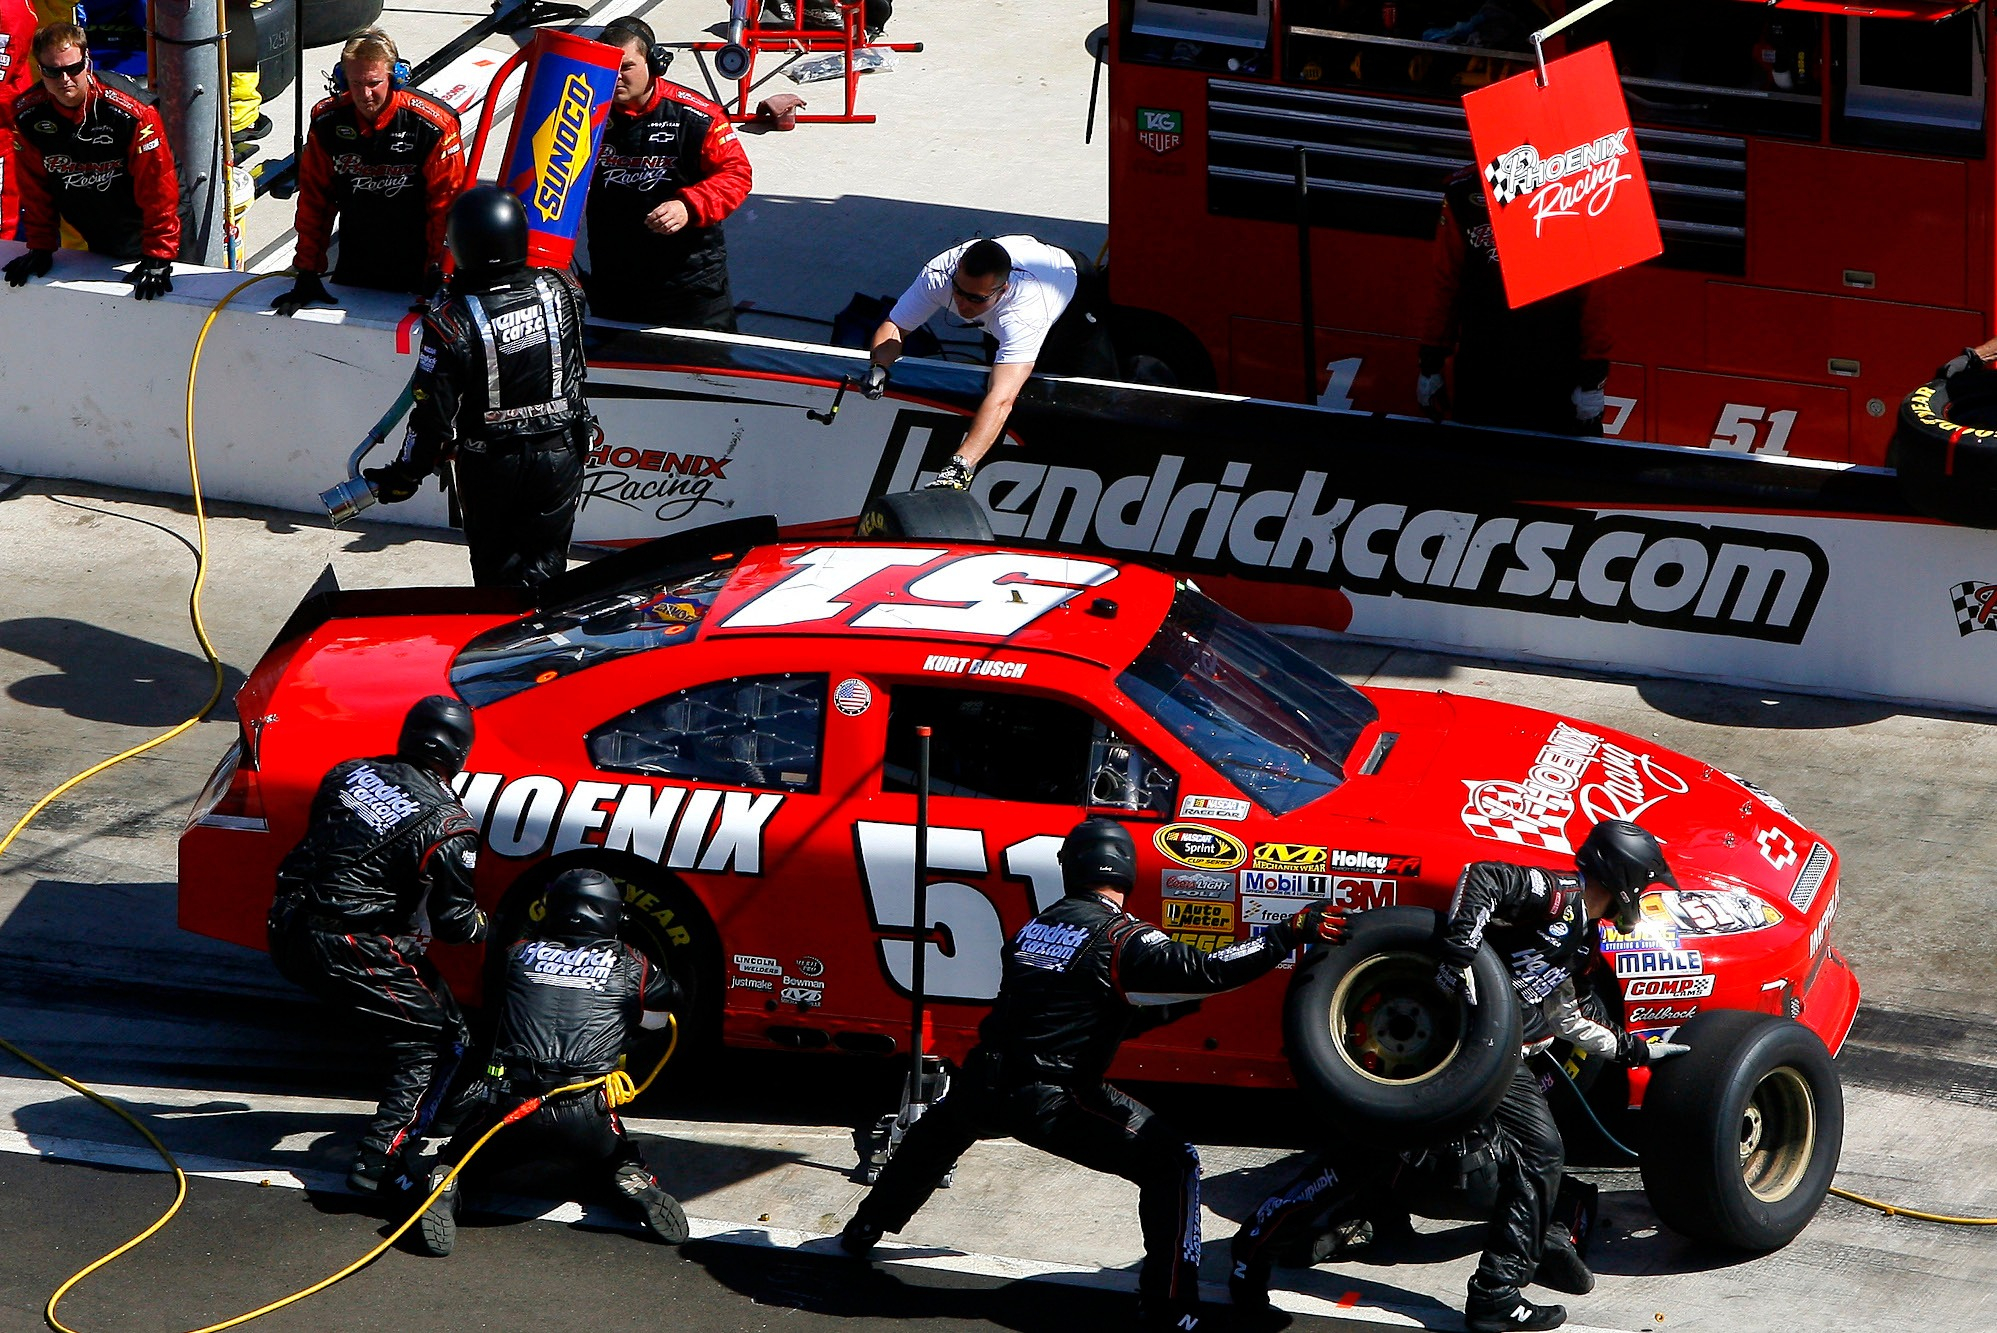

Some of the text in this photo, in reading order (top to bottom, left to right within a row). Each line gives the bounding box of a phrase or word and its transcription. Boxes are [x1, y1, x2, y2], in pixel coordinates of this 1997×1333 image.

[1144, 111, 1175, 131] TAG
[534, 78, 595, 218] SUNOCO
[1140, 132, 1180, 152] HEUER
[1500, 127, 1630, 194] PHOENIX
[62, 170, 124, 192] Racing
[351, 174, 414, 198] Racing
[602, 167, 672, 192] Racing
[1527, 157, 1633, 239] Racing
[1710, 403, 1797, 456] 51
[586, 424, 733, 481] HOENIX
[580, 470, 734, 521] Racing
[720, 546, 1120, 637] 51
[923, 654, 1028, 679] KURT BUSCH
[1473, 721, 1604, 828] PHOENIX
[346, 764, 420, 819] Hendrick
[1579, 738, 1690, 843] Racing
[349, 785, 402, 826] cars.com
[450, 771, 784, 874] HOENIX
[1184, 842, 1216, 855] Sprint
[1187, 856, 1234, 866] CUP SERIES
[1253, 860, 1326, 873] MECHANIX WEAR
[1332, 850, 1389, 875] Holley
[1196, 879, 1231, 891] LIGHT
[1246, 872, 1302, 892] Mobil
[1173, 890, 1222, 899] POLE
[1336, 879, 1395, 912] 3M
[1180, 915, 1230, 927] Meter
[1183, 904, 1222, 916] Auto
[1678, 897, 1736, 929] 51
[1015, 917, 1090, 948] Hendrick
[520, 940, 618, 969] Hendrick
[735, 956, 776, 966] LINCOLN
[1617, 951, 1701, 974] MAHLE
[535, 959, 612, 979] cars.com
[743, 965, 780, 975] WELDERS
[731, 975, 773, 990] justmake
[783, 975, 825, 989] Bowman
[1630, 979, 1694, 996] COMP
[1672, 989, 1704, 998] CAMS
[1629, 1005, 1699, 1023] Edelbrock
[1177, 1313, 1199, 1331] N
[1509, 1304, 1533, 1323] N
